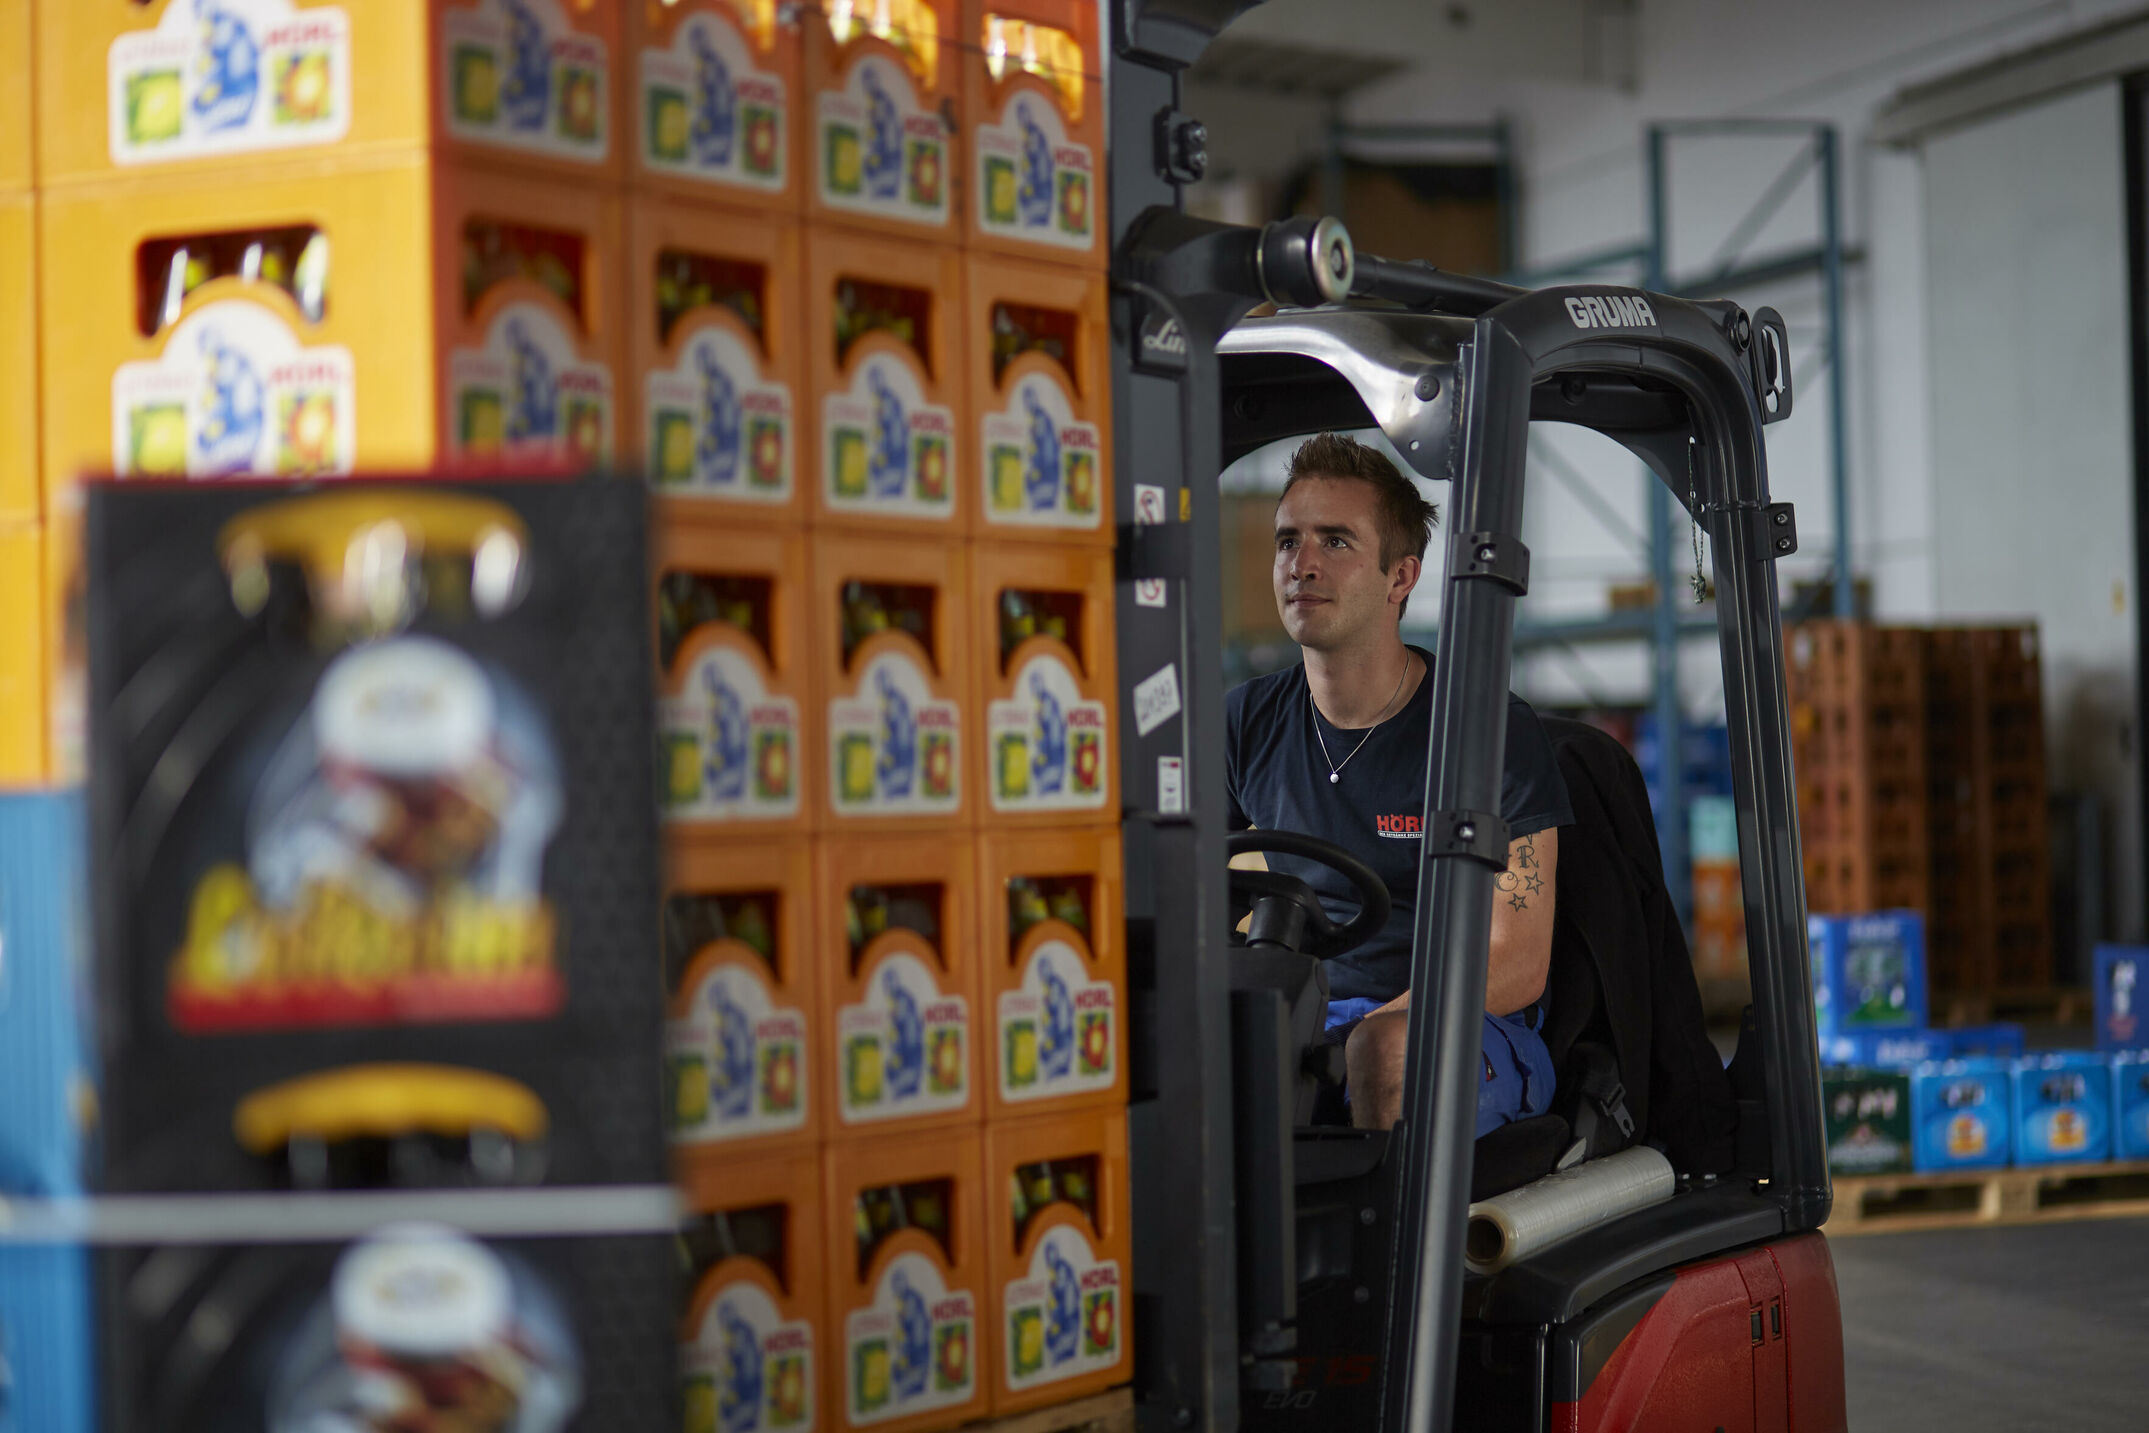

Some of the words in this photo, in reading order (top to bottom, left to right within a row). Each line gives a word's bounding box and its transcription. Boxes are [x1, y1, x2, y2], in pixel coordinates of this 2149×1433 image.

[1564, 296, 1656, 328] GRUMA
[1143, 318, 1187, 354] Lin
[1264, 1390, 1317, 1409] EVO
